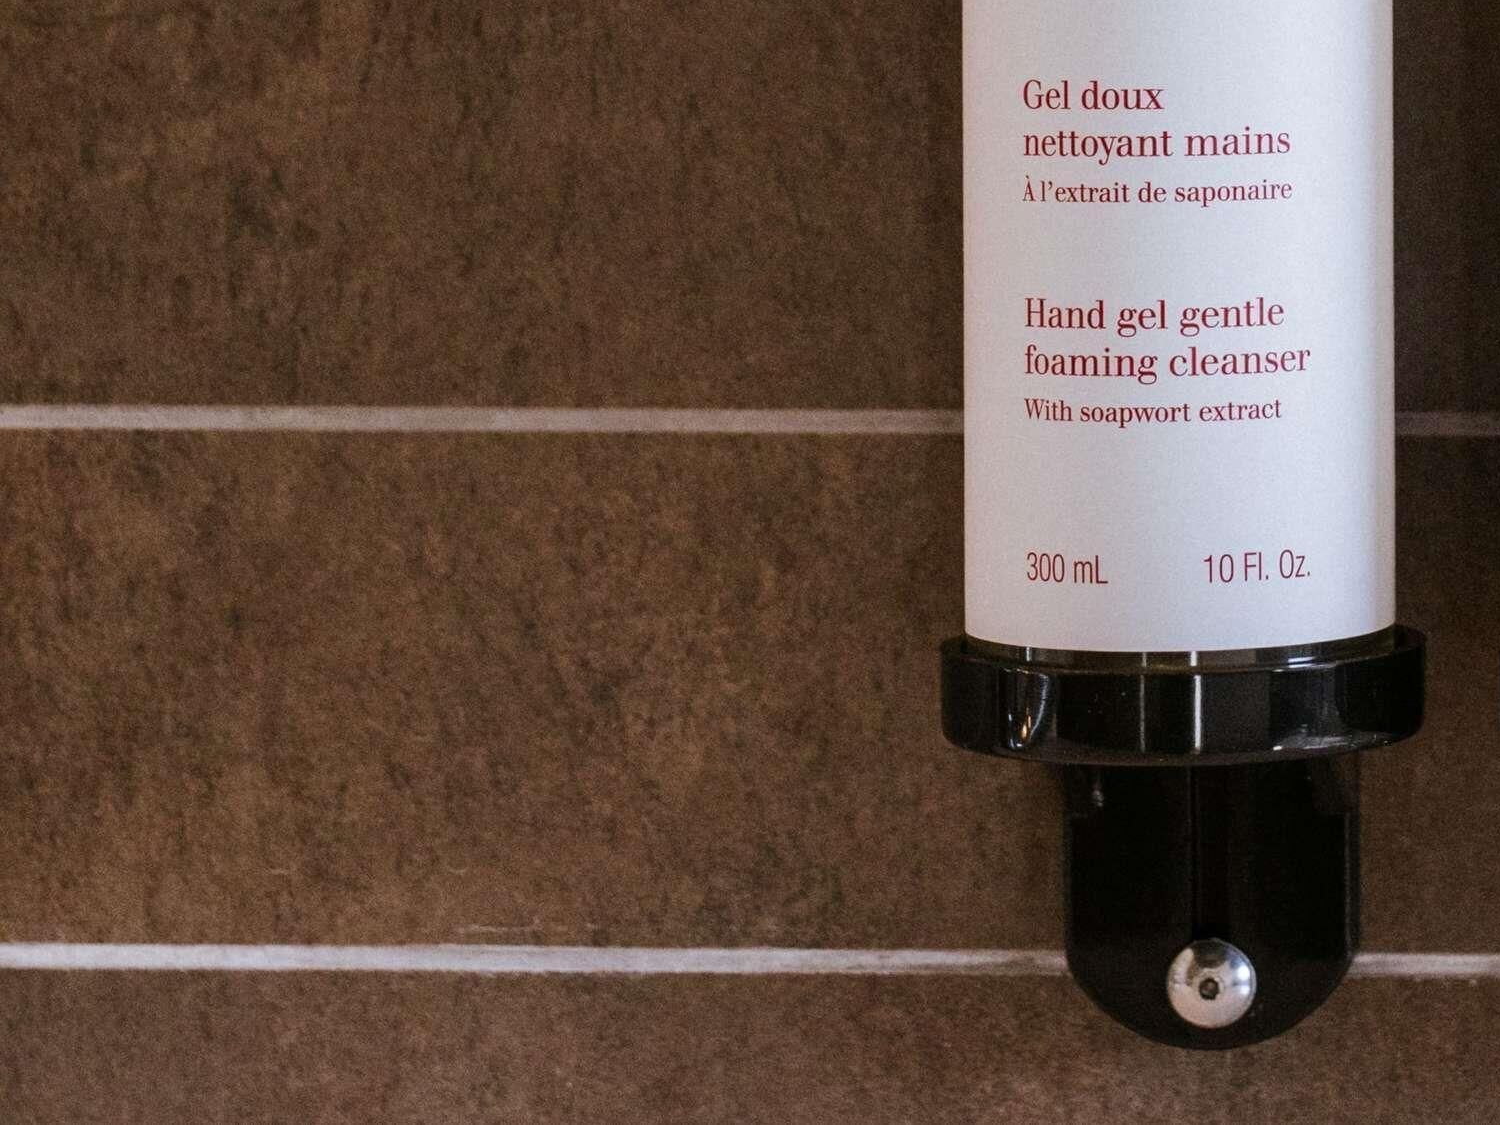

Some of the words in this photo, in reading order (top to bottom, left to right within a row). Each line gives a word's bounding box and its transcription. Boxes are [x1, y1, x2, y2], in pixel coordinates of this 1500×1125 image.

[1022, 78, 1072, 111] Gel
[1079, 79, 1166, 112] doux
[1022, 130, 1175, 167] nettoyant
[1183, 125, 1291, 157] mains
[1021, 174, 1037, 203] À
[1137, 180, 1168, 204] de
[1173, 178, 1293, 209] saponaire
[1024, 297, 1107, 332] Hand
[1116, 299, 1169, 339] gel
[1179, 296, 1285, 338] gentle
[1023, 343, 1159, 386] foaming
[1168, 345, 1311, 377] cleanser
[1023, 397, 1075, 422] With
[1079, 402, 1192, 430] soapwort
[1198, 398, 1283, 423] extract
[1026, 551, 1066, 584] 300
[1071, 554, 1110, 585] mL
[1203, 553, 1235, 584] 10
[1243, 551, 1270, 583] Fl.
[1278, 548, 1311, 580] Oz.
